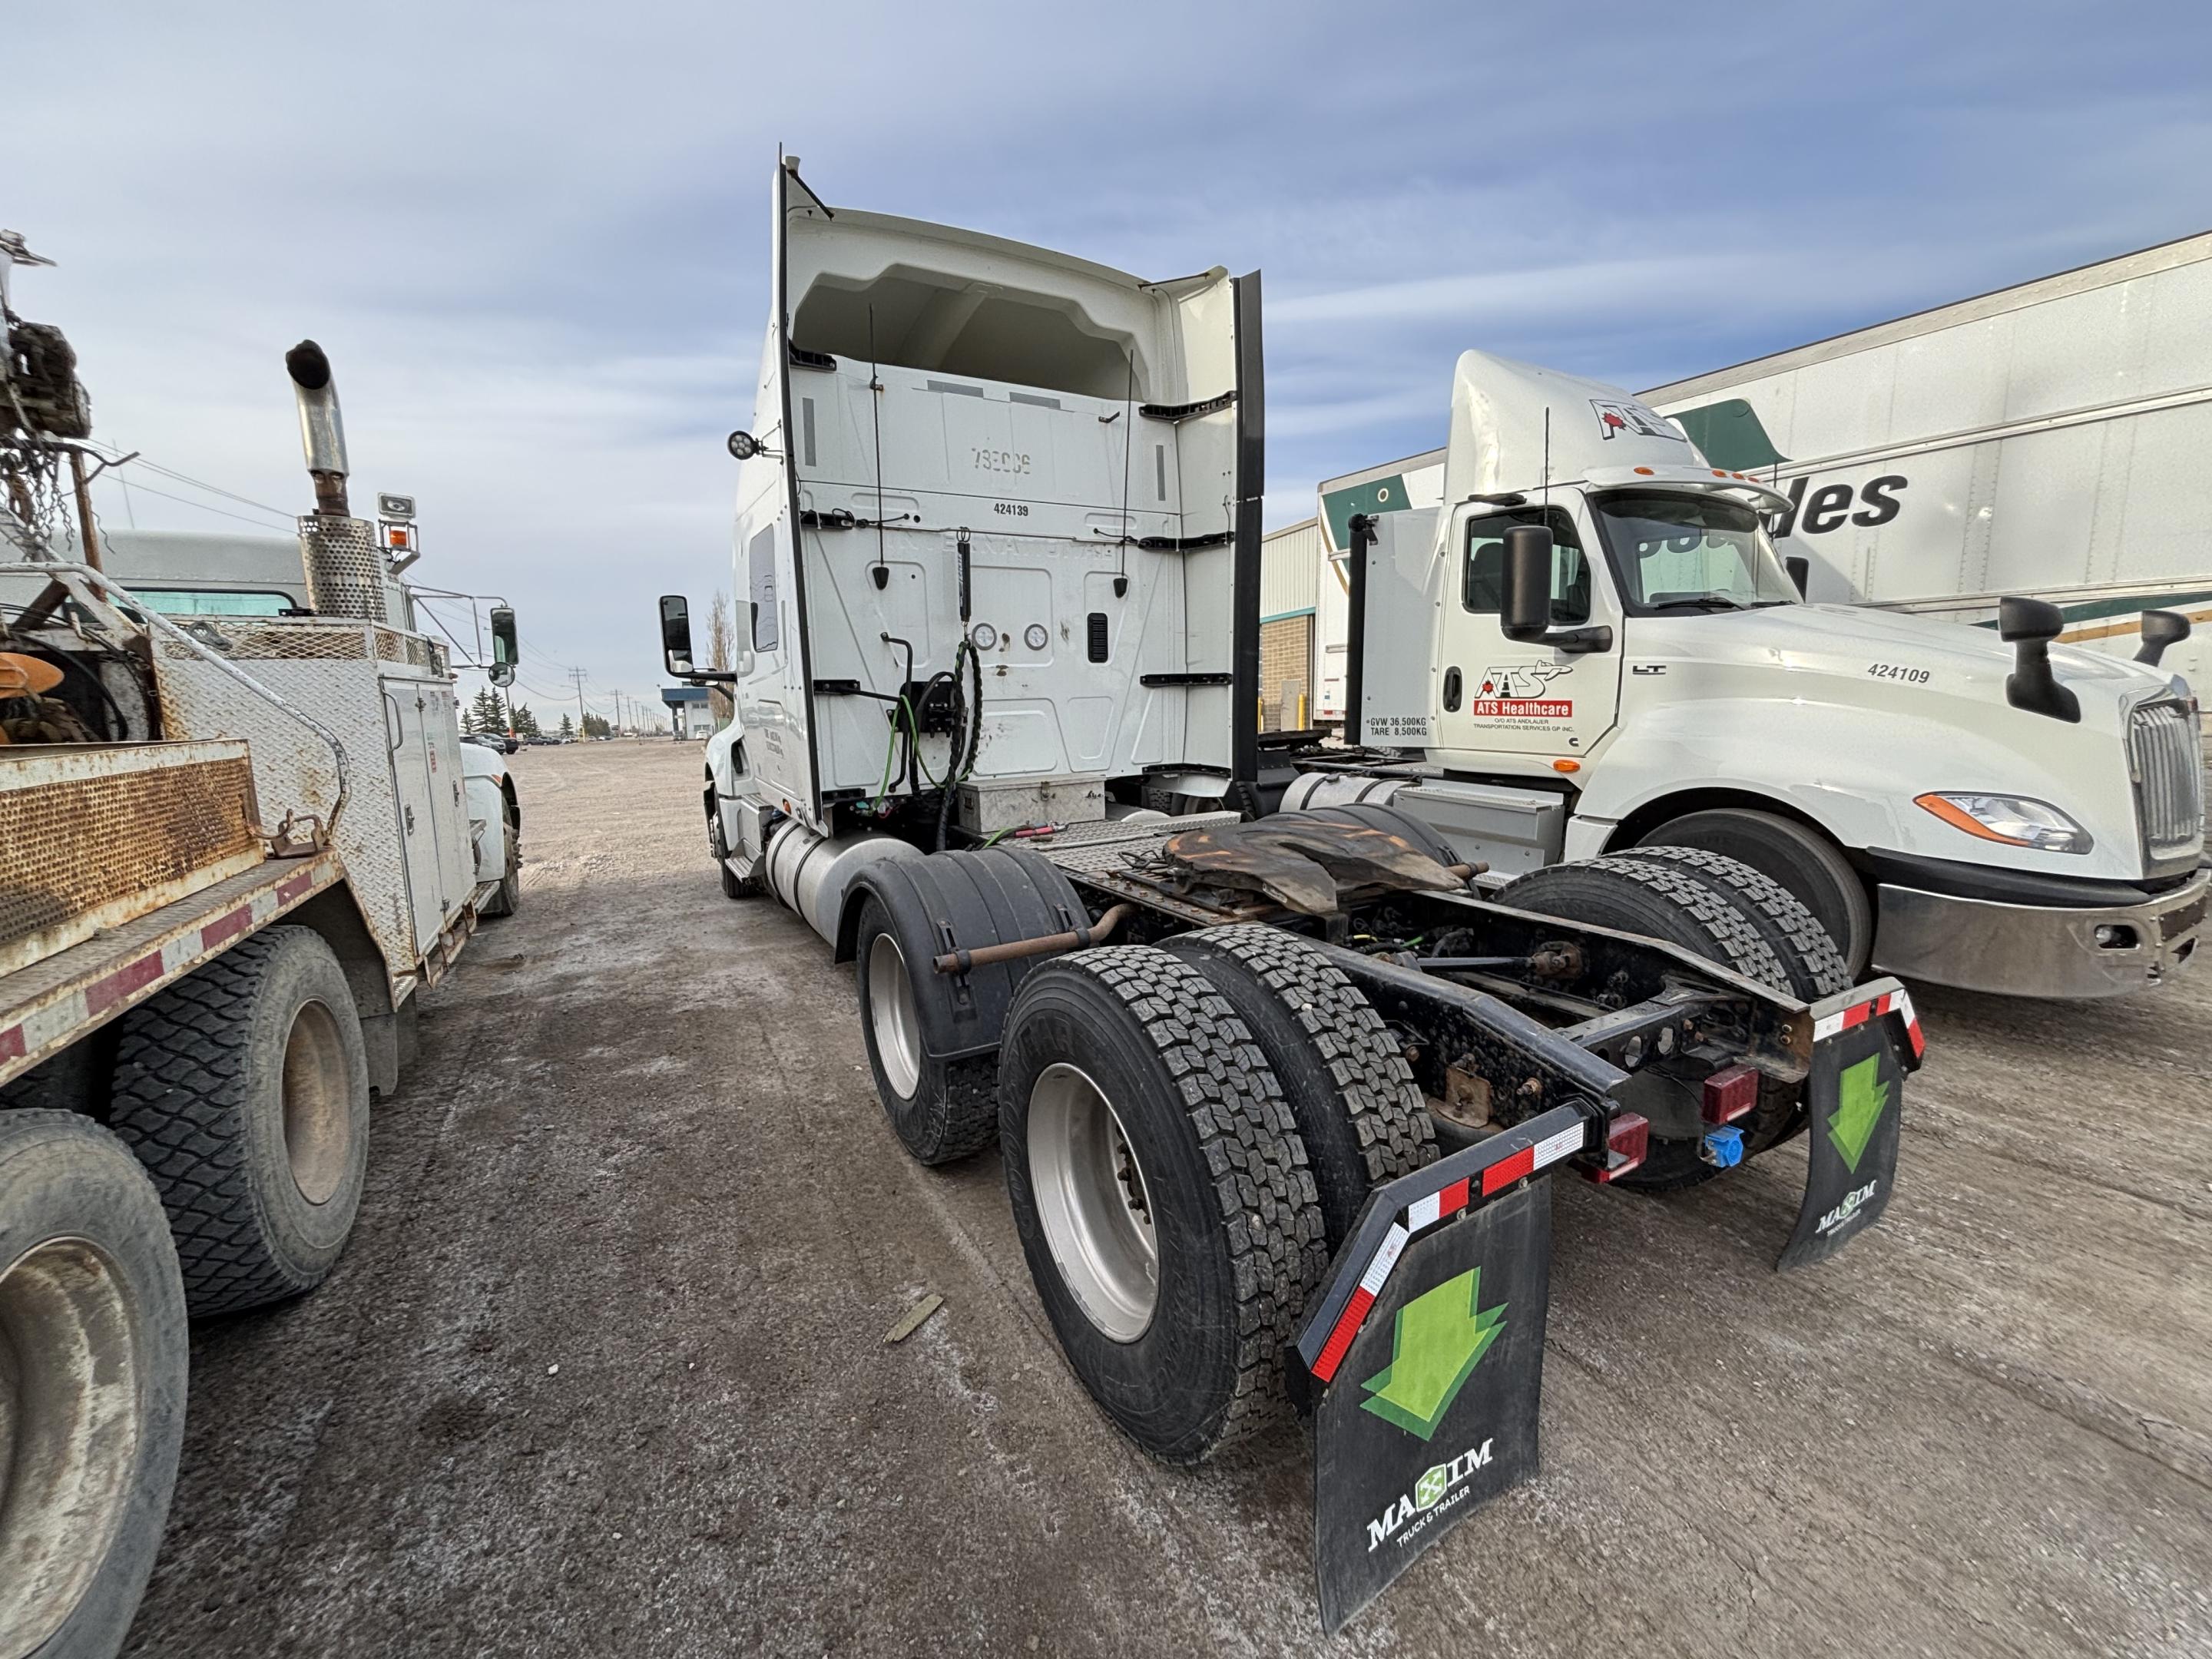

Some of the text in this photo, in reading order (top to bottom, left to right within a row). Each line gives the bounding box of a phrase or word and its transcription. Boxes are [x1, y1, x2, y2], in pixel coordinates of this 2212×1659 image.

[994, 502, 1029, 517] 424139
[1475, 664, 1547, 699] ATS
[1868, 664, 1930, 684] 424109
[1477, 702, 1568, 716] ATS Healthcare
[1370, 717, 1426, 727] GVW 36,500KG
[1370, 727, 1427, 736] TARE 8,500KG
[1815, 1179, 1877, 1233] MAXIM
[1366, 1437, 1493, 1553] MAXIM
[1396, 1485, 1470, 1548] TRUCK & TRAILER
